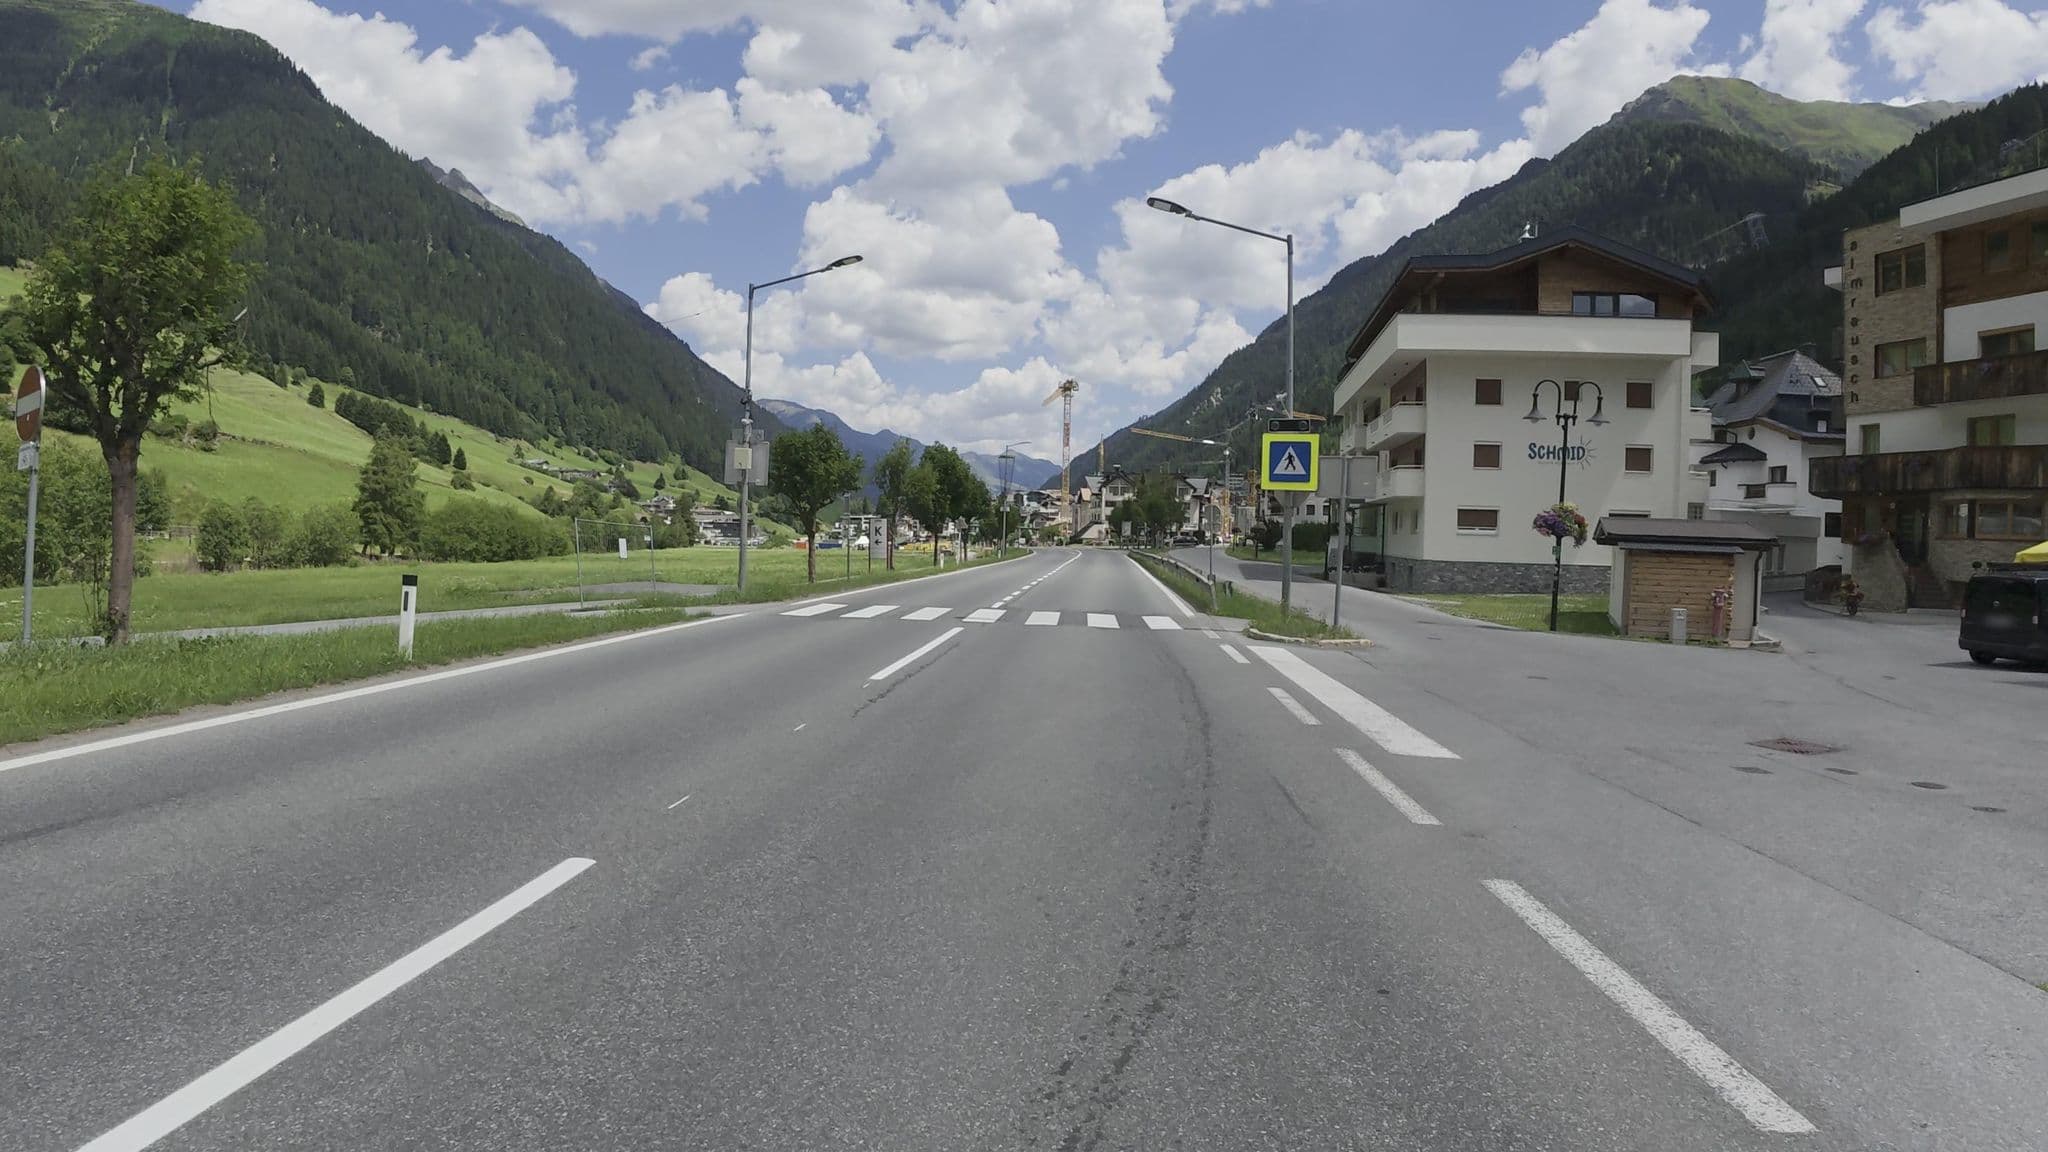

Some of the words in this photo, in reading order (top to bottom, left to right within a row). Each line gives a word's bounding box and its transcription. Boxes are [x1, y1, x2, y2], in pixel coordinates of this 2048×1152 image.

[1850, 240, 1862, 403] almrausch
[1528, 442, 1586, 461] SCHMID
[874, 526, 882, 537] K
